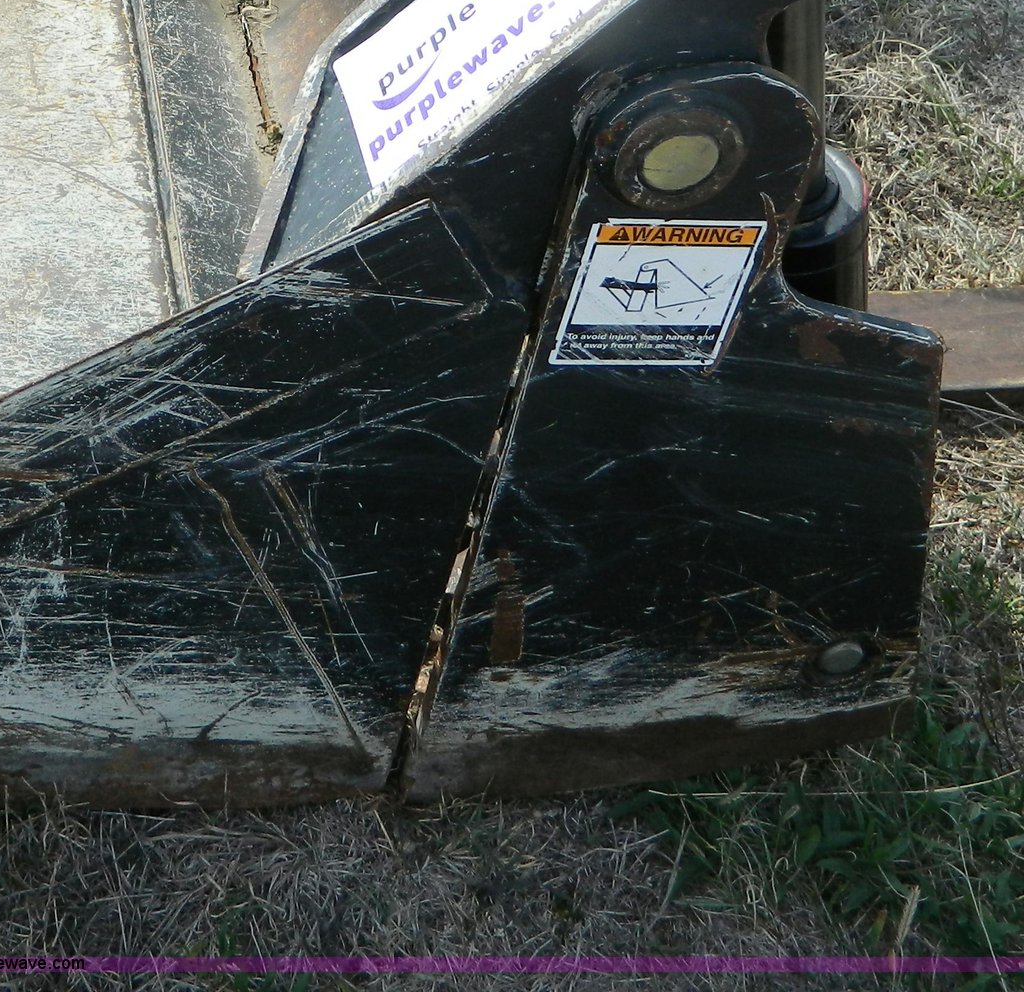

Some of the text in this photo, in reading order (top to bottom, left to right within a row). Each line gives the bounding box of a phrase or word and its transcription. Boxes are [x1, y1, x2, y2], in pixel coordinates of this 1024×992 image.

[377, 2, 477, 95] purple
[632, 226, 743, 243] WARNING
[580, 332, 607, 341] avoid
[608, 332, 638, 343] injury,
[665, 333, 695, 341] hands
[697, 333, 715, 341] and
[583, 342, 608, 350] away
[610, 342, 633, 350] from
[635, 342, 653, 350] this
